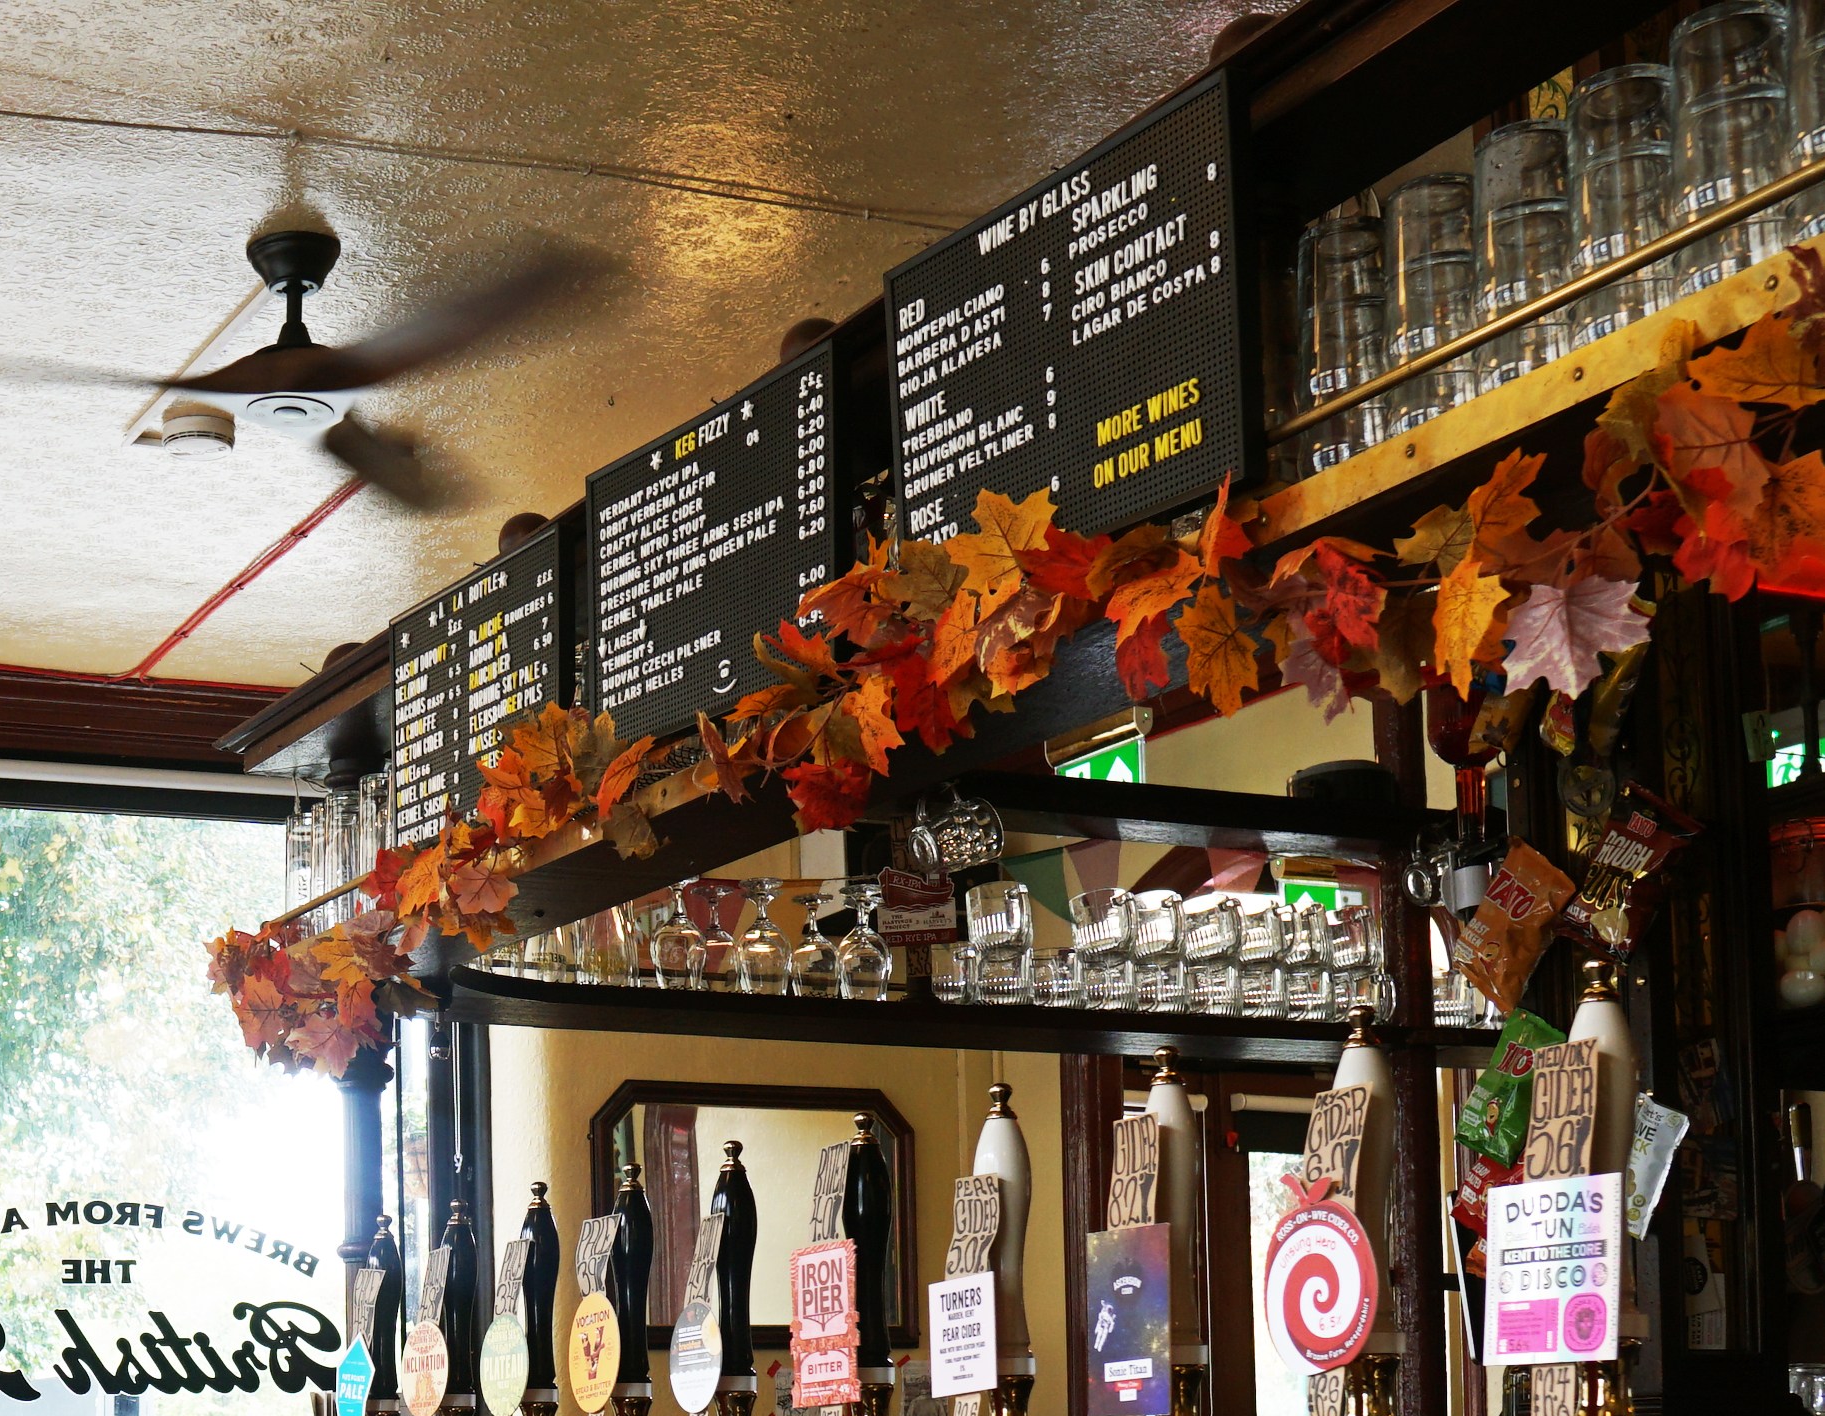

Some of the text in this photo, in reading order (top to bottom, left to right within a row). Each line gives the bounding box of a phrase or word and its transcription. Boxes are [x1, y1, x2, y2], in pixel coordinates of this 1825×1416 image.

[978, 170, 1091, 255] WINE BY GLASS
[1072, 164, 1158, 232] SPARKLING
[1068, 203, 1149, 260] PROSECCO
[1075, 213, 1187, 295] SKIN CONTACT
[1071, 258, 1168, 321] CIRO BIANCO
[1072, 264, 1206, 346] LAGAR DE COSTA
[896, 284, 1005, 356] MONTEPULCIANO
[898, 299, 925, 332] RED
[897, 306, 1006, 377] BARBERA D ASTI
[899, 332, 1003, 399] RIOJA ALAVESA
[902, 408, 974, 456] TREBBIANO
[904, 390, 947, 431] WHITE
[1096, 378, 1201, 447] MORE WINES
[599, 394, 824, 524] VERDANT PSYCH IPA 6.40
[675, 412, 731, 460] KEG FIZZY
[904, 405, 1024, 478] SAUVIGNON BLANC
[1093, 418, 1203, 490] ON OUR MENU
[599, 414, 825, 542] ORBIT VERBENA KAFFIR 6.20
[904, 424, 1035, 499] GRUNER VELTLINER
[599, 434, 825, 560] CRAFTY ALICE CIDER 6.00
[600, 455, 825, 579] KERNEL NITRO STOUT 6.80
[910, 497, 945, 534] ROSE
[600, 475, 825, 597] BURNING SKY THREE ARMS SESH IPA 6.80
[600, 495, 825, 615] PRESSURE DROP KING QUEEN PALE 7.60
[601, 516, 826, 633] KERNEL TABLE PALE 6.20
[798, 564, 826, 587] 6.00
[519, 661, 541, 687] PALE
[602, 629, 722, 693] BUDVAR CZECH PILSNER
[524, 683, 543, 707] PILS
[602, 665, 684, 711] PILLARS HELLES
[1595, 830, 1654, 872] ROUGH
[892, 875, 922, 889] RX-IPA
[885, 931, 937, 944] RED RYE IPA
[1533, 1067, 1593, 1123] CIDER
[1308, 1087, 1367, 1153] CIDER
[1114, 1114, 1157, 1176] CIDER
[1527, 1115, 1591, 1180] 5.6%
[956, 1176, 998, 1198] PEAR
[1110, 1172, 1155, 1228] 8.2%
[1506, 1190, 1604, 1223] DUDDA'S
[955, 1197, 998, 1234] CIDER
[1276, 1210, 1358, 1246] ROSS-ON-WYE CIDER CO.
[1532, 1217, 1573, 1240] TUN
[802, 1257, 843, 1288] IRON
[947, 1234, 995, 1275] 5.0%
[1280, 1235, 1337, 1269] Unsung Hero
[1503, 1242, 1603, 1264] KENT TO THE CORE
[802, 1284, 843, 1316] PIER
[940, 1287, 982, 1312] TURNERS
[1520, 1265, 1587, 1291] DISCO
[576, 1309, 611, 1329] VOCATION
[943, 1322, 981, 1342] PEAR CIDER
[403, 1353, 445, 1374] INCLINATION
[484, 1352, 524, 1381] PLATEAU
[808, 1361, 843, 1375] BITTER
[1109, 1363, 1147, 1377] Sonic Titan
[339, 1382, 365, 1400] PALE
